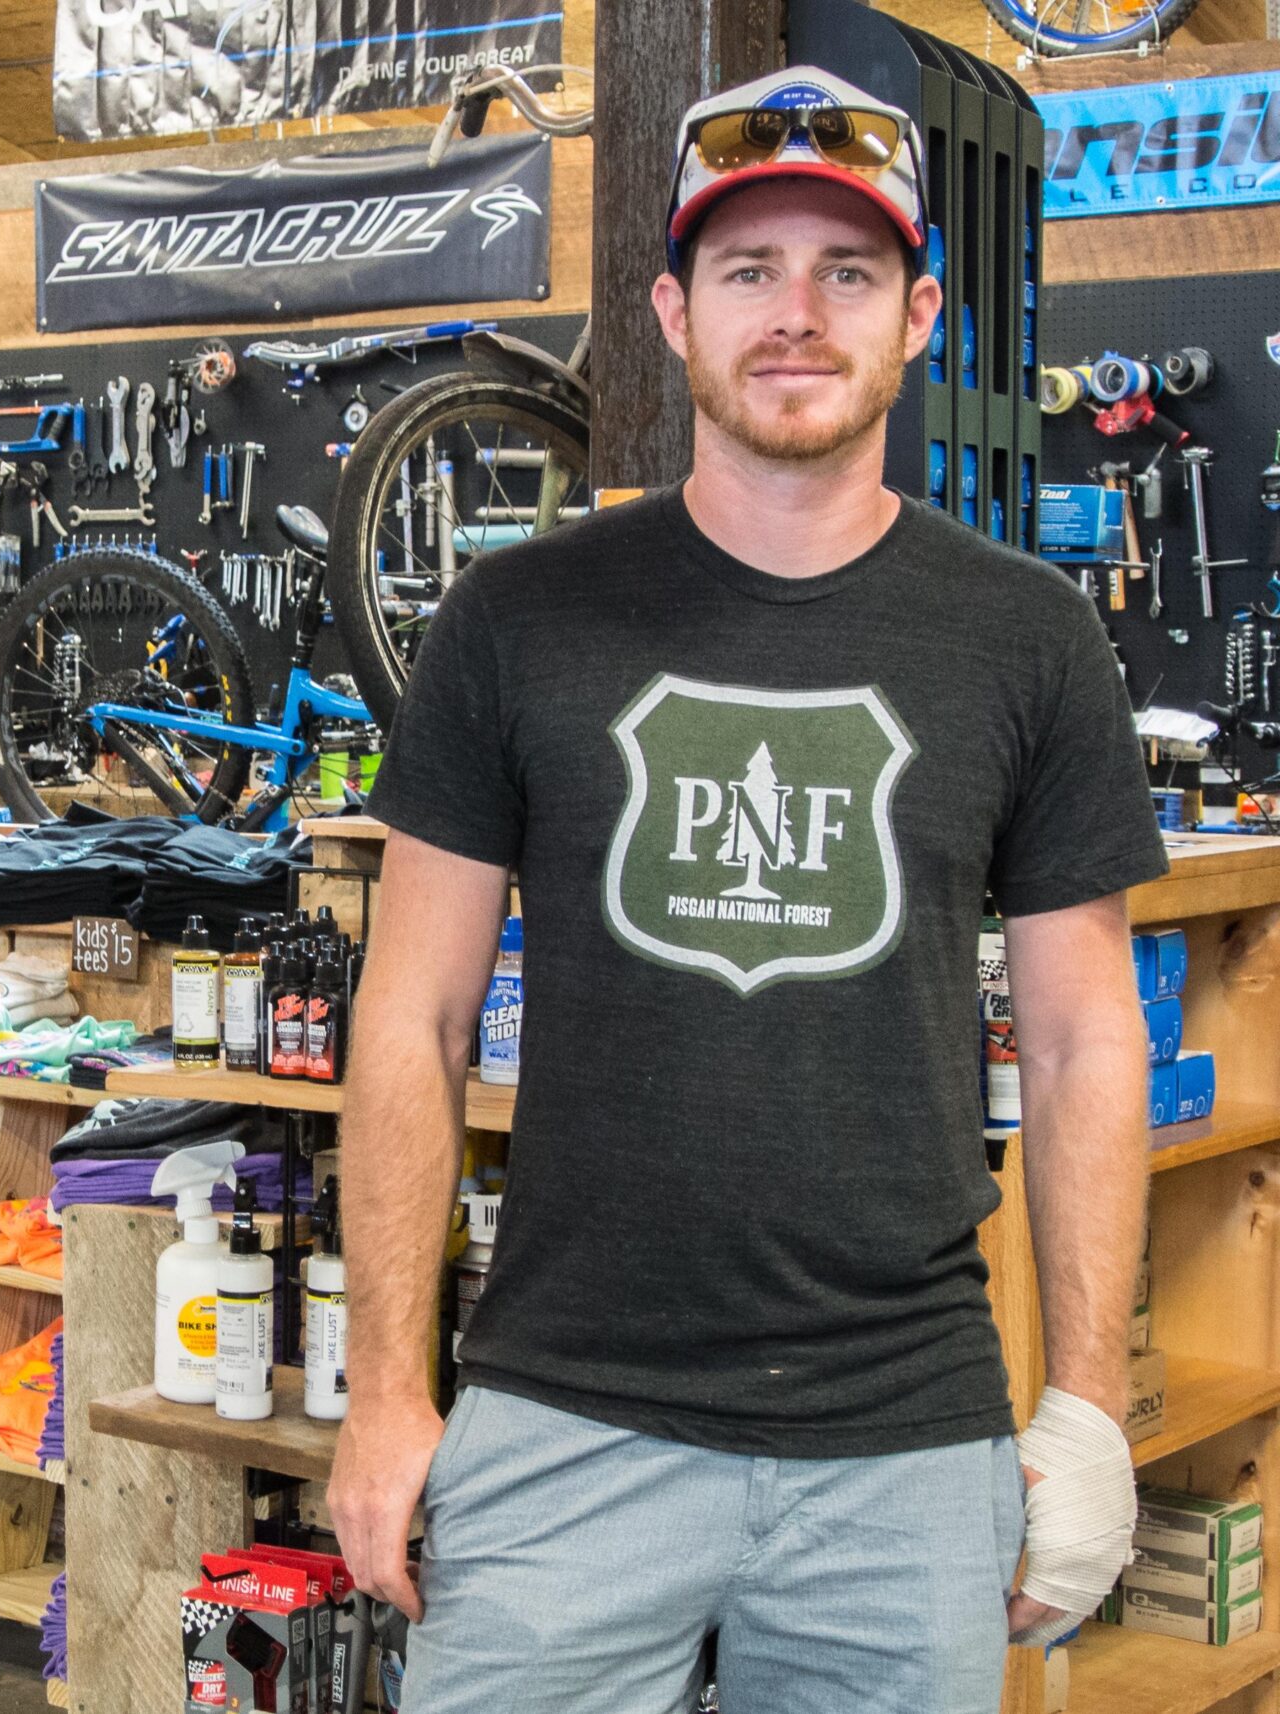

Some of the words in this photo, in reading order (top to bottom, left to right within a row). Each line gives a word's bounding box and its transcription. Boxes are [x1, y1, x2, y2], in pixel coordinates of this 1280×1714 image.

[416, 54, 469, 76] YOUR
[473, 45, 535, 67] GREAT
[668, 895, 717, 920] PISGAH
[718, 899, 782, 924] NATIONAL
[784, 904, 832, 927] FOREST
[76, 919, 109, 948] kids
[74, 949, 108, 973] tees
[495, 980, 514, 989] WHITE
[489, 1051, 509, 1059] WAX
[178, 1321, 202, 1331] BIKE
[257, 1311, 267, 1338] LUST
[328, 1311, 338, 1337] LUST
[263, 1583, 296, 1603] LINE
[201, 1683, 223, 1694] DRY
